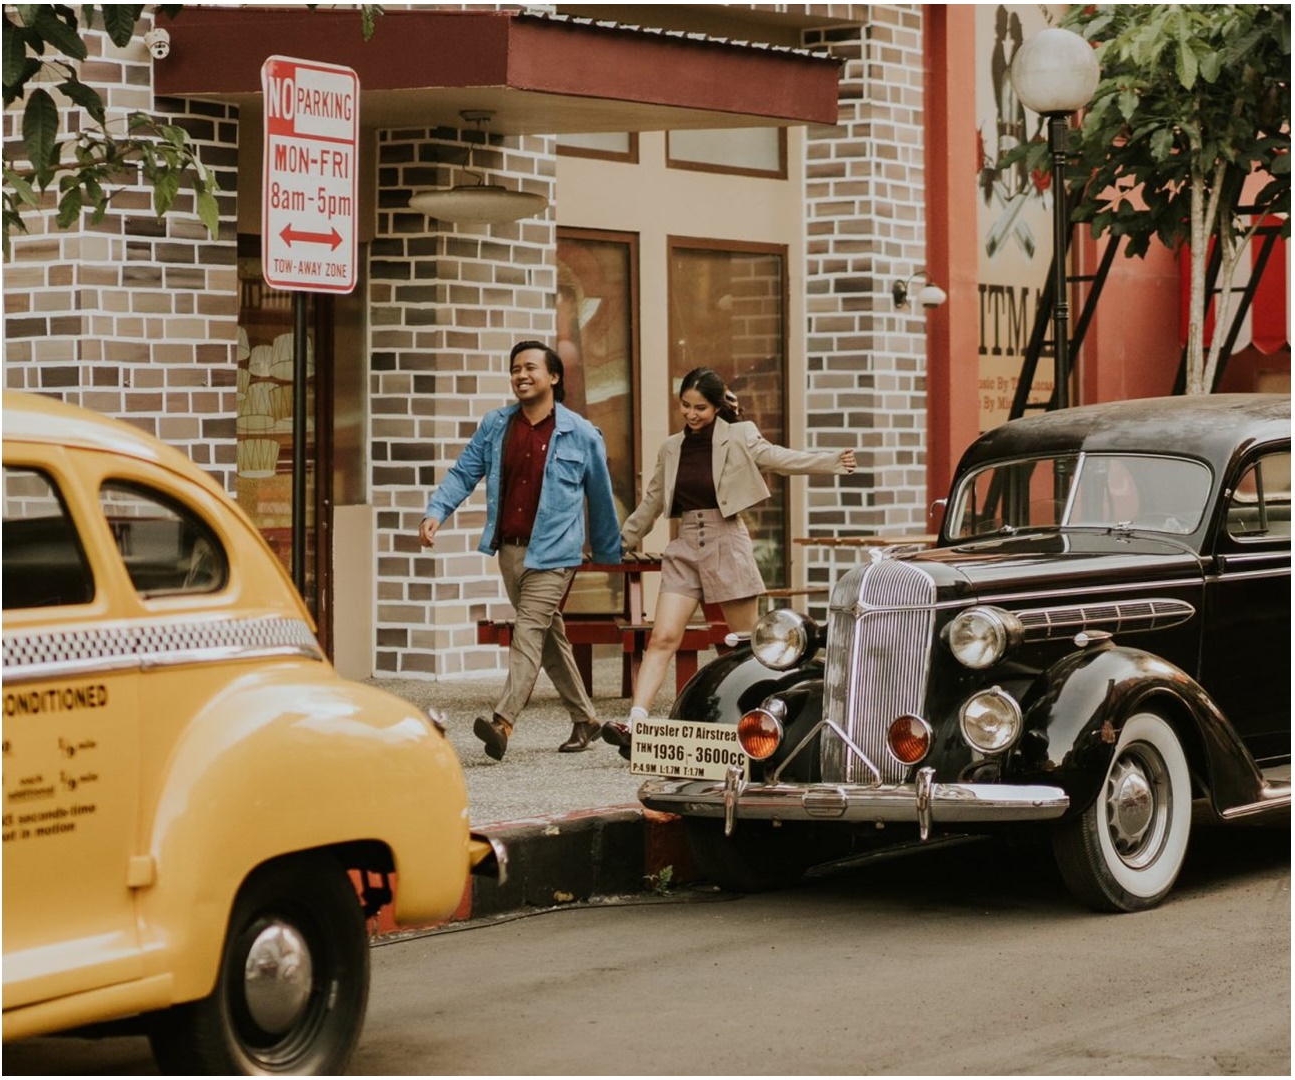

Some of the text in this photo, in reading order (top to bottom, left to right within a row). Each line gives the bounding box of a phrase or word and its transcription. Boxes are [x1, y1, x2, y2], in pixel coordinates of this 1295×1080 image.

[268, 76, 352, 122] NO PARKING
[274, 144, 349, 179] MON-FRI
[274, 259, 348, 278] TOW-AWAY ZONE
[978, 283, 1055, 357] ITM
[997, 376, 1008, 393] By
[983, 396, 995, 412] By
[2, 685, 108, 717] ONDITIONED
[636, 722, 737, 741] Chrysler C7 Airstrea
[636, 742, 652, 753] THN
[653, 744, 684, 761] 1936
[696, 747, 745, 766] 3600cc
